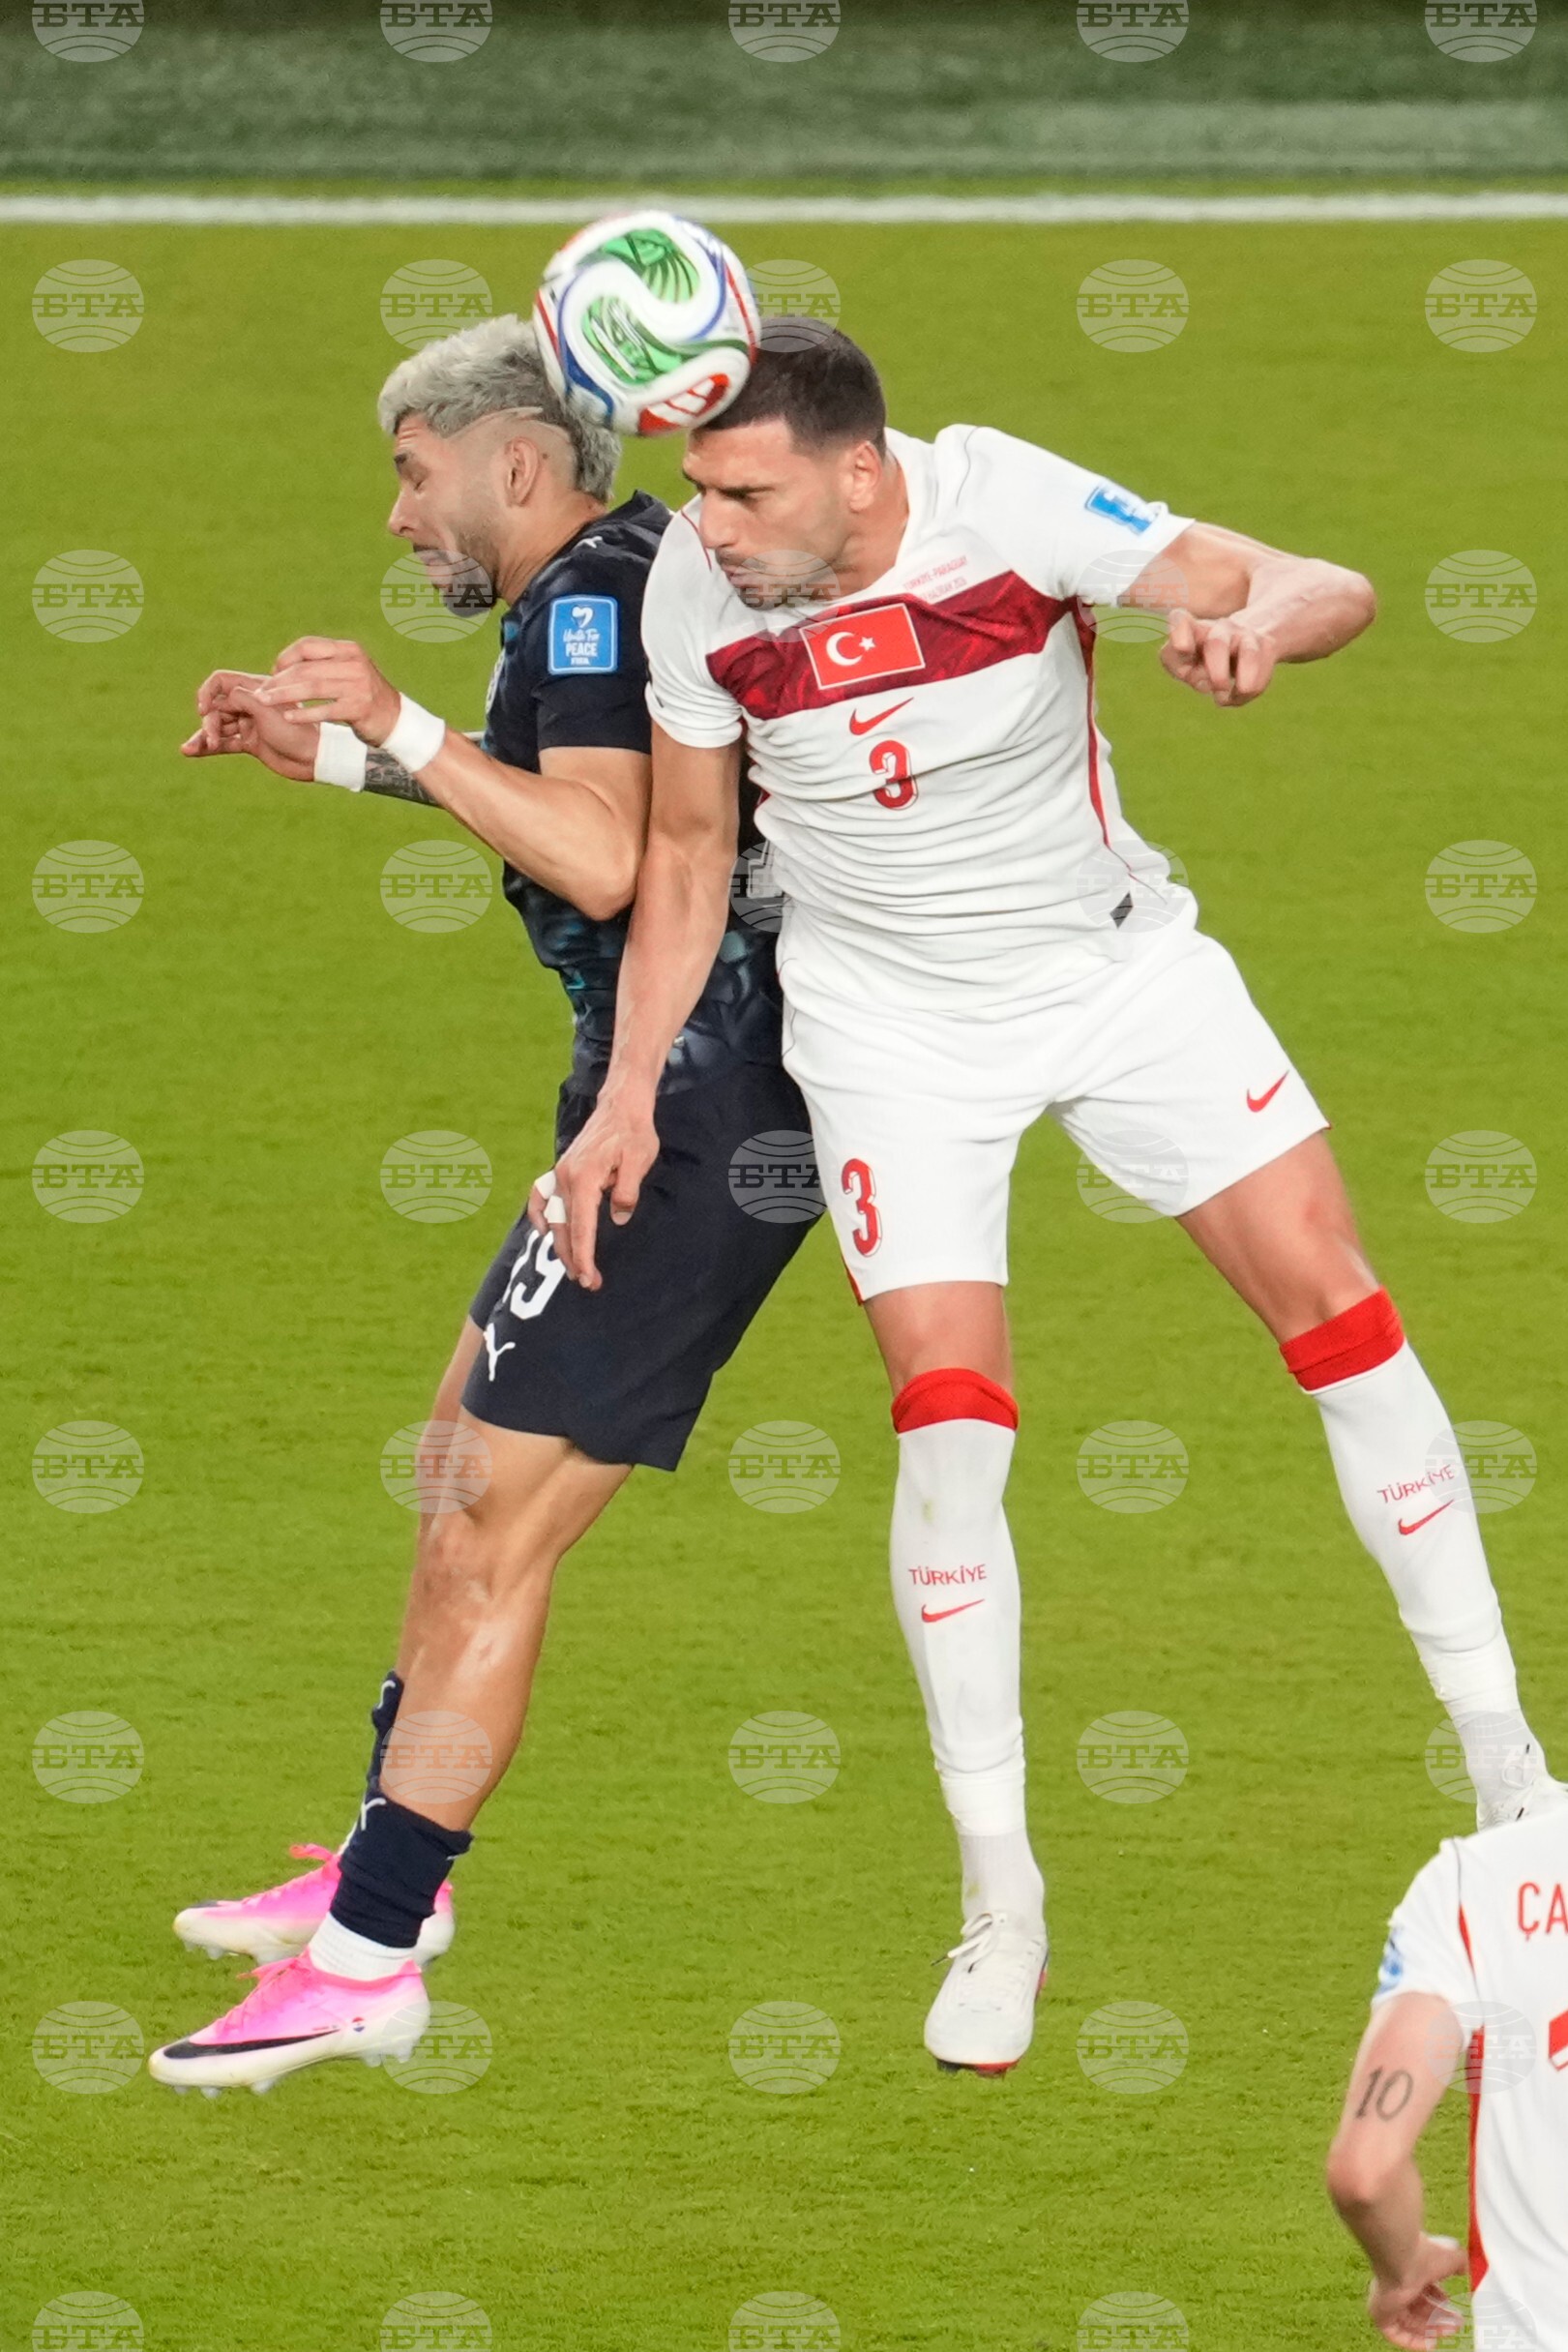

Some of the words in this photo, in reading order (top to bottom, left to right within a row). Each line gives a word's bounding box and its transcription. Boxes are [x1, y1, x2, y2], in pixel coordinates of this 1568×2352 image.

[566, 641, 598, 657] PEACE
[870, 740, 918, 811] 3
[842, 1158, 882, 1257] 3
[502, 1229, 566, 1320] 19
[1376, 1464, 1455, 1503] TÜRKİYE
[908, 1563, 987, 1586] TÜRKİYE
[1356, 2067, 1414, 2122] 10
